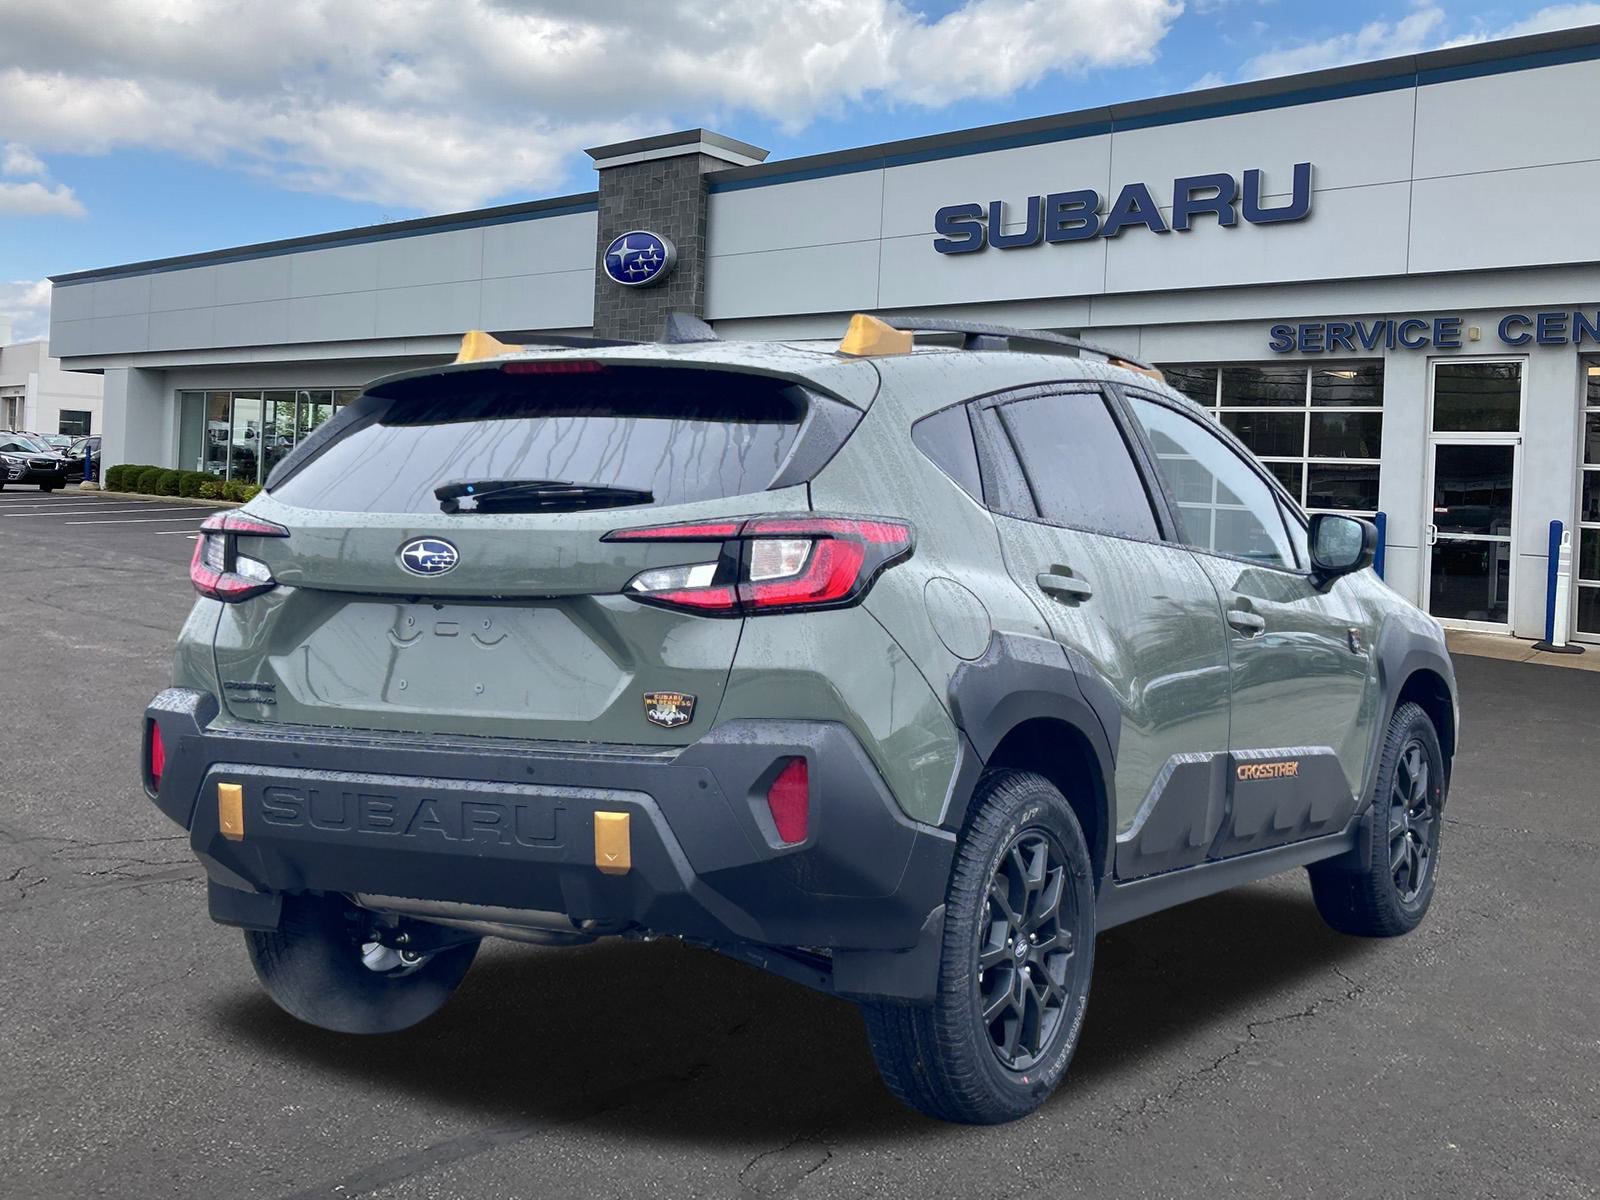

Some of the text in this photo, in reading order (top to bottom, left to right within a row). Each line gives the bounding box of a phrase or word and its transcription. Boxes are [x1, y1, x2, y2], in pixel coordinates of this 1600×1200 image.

[933, 162, 1314, 255] SUBARU
[1268, 311, 1600, 352] SERVICE CEN
[1237, 761, 1299, 780] CROSSTREK
[261, 785, 566, 849] SUBARU
